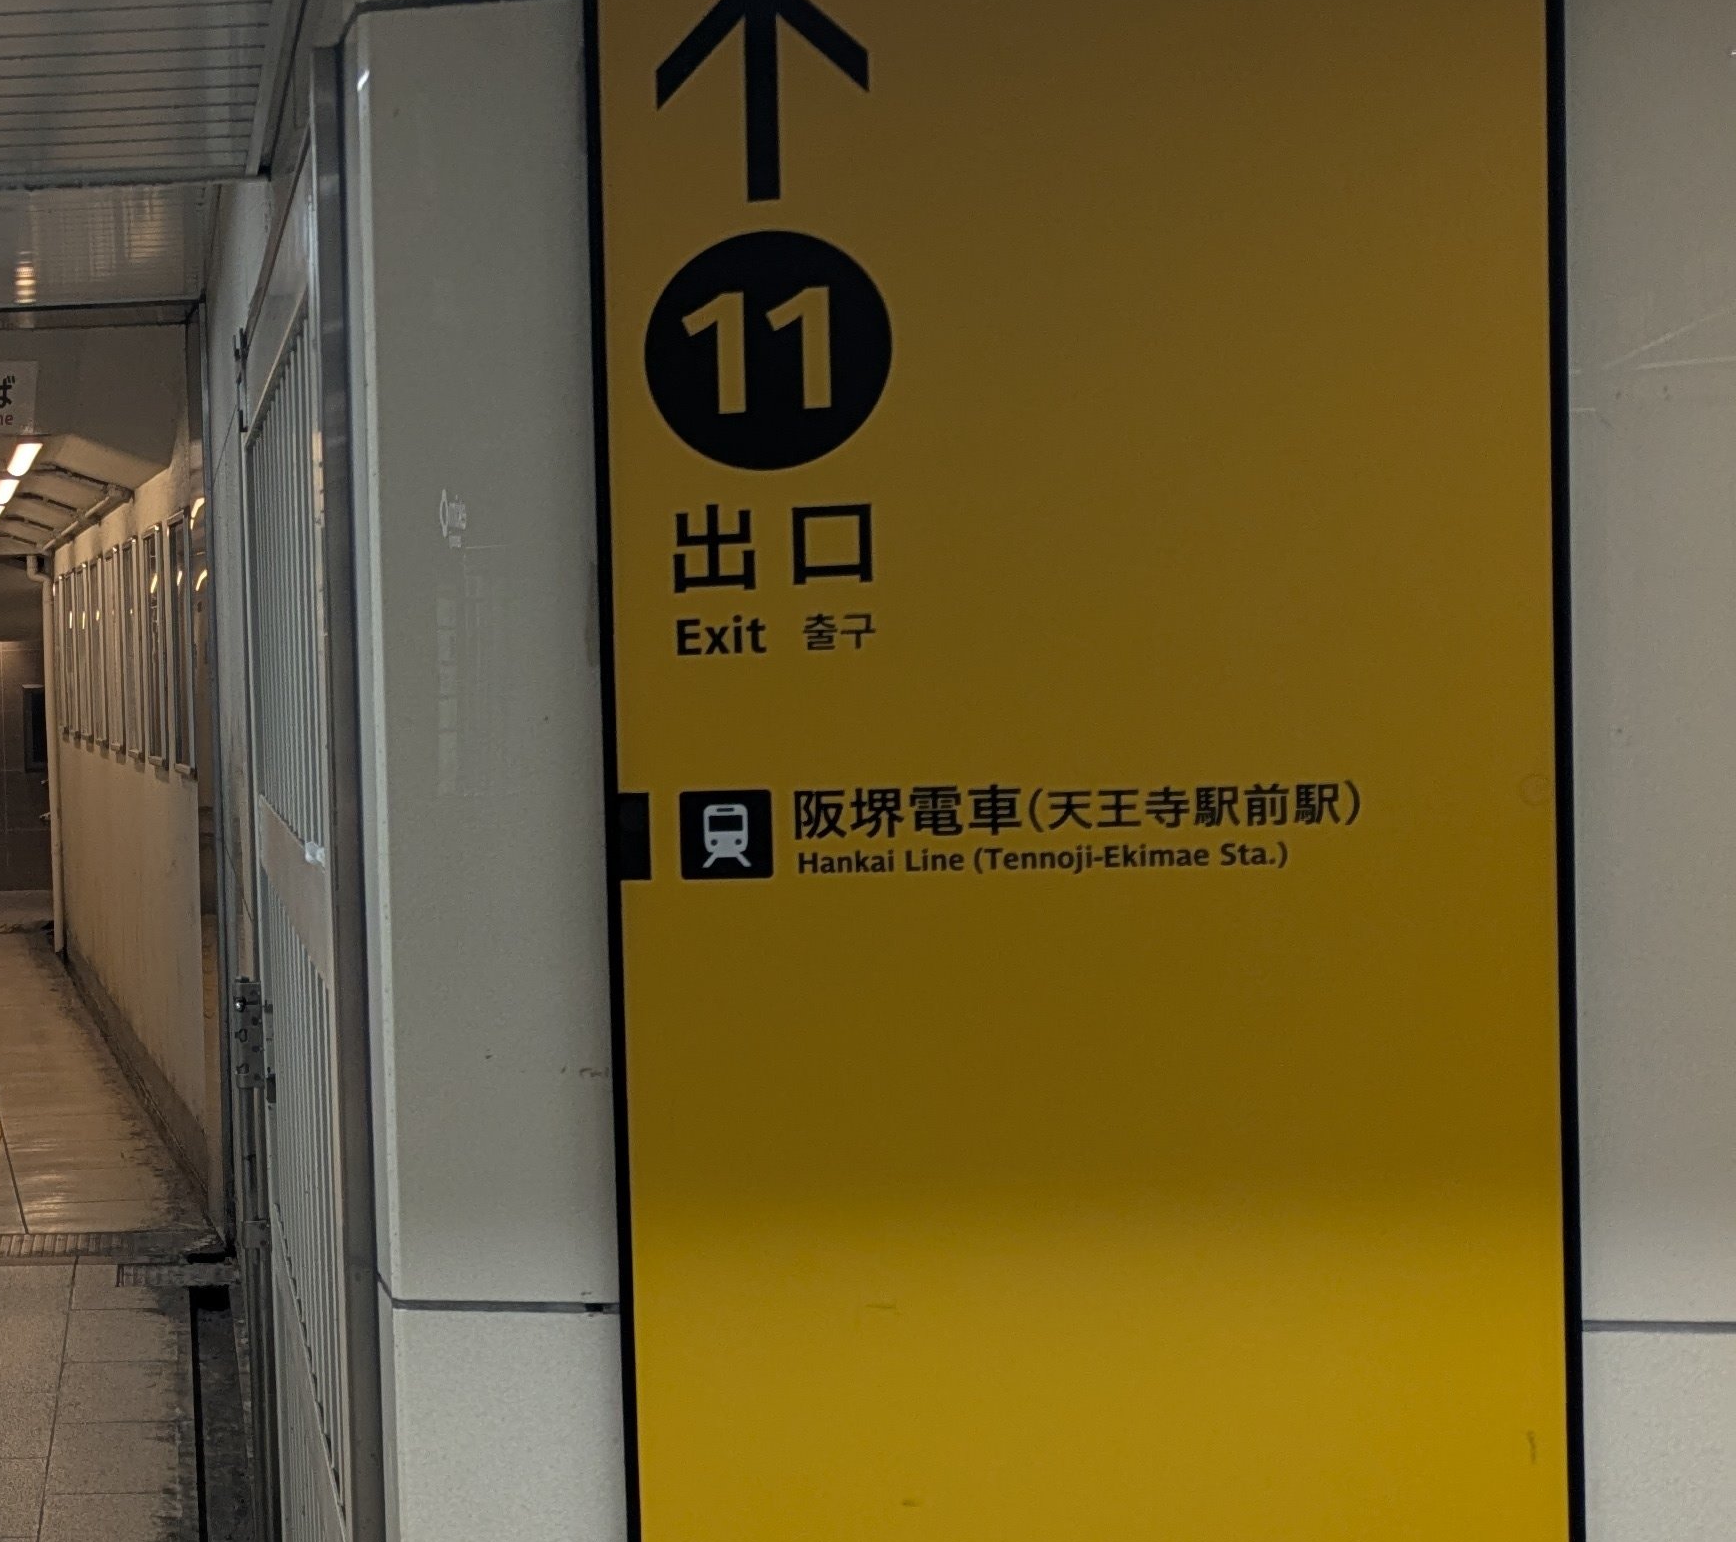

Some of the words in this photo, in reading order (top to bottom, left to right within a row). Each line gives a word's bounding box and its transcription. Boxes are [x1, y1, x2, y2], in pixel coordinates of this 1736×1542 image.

[681, 286, 832, 415] 11
[672, 503, 873, 594] 出口
[676, 614, 768, 657] Exit
[802, 613, 877, 651] 출구
[797, 849, 895, 875] Hankai
[904, 847, 965, 873] Line
[973, 841, 1210, 875] (Tennoji-Ekimae
[1219, 840, 1290, 870] Sta.)
